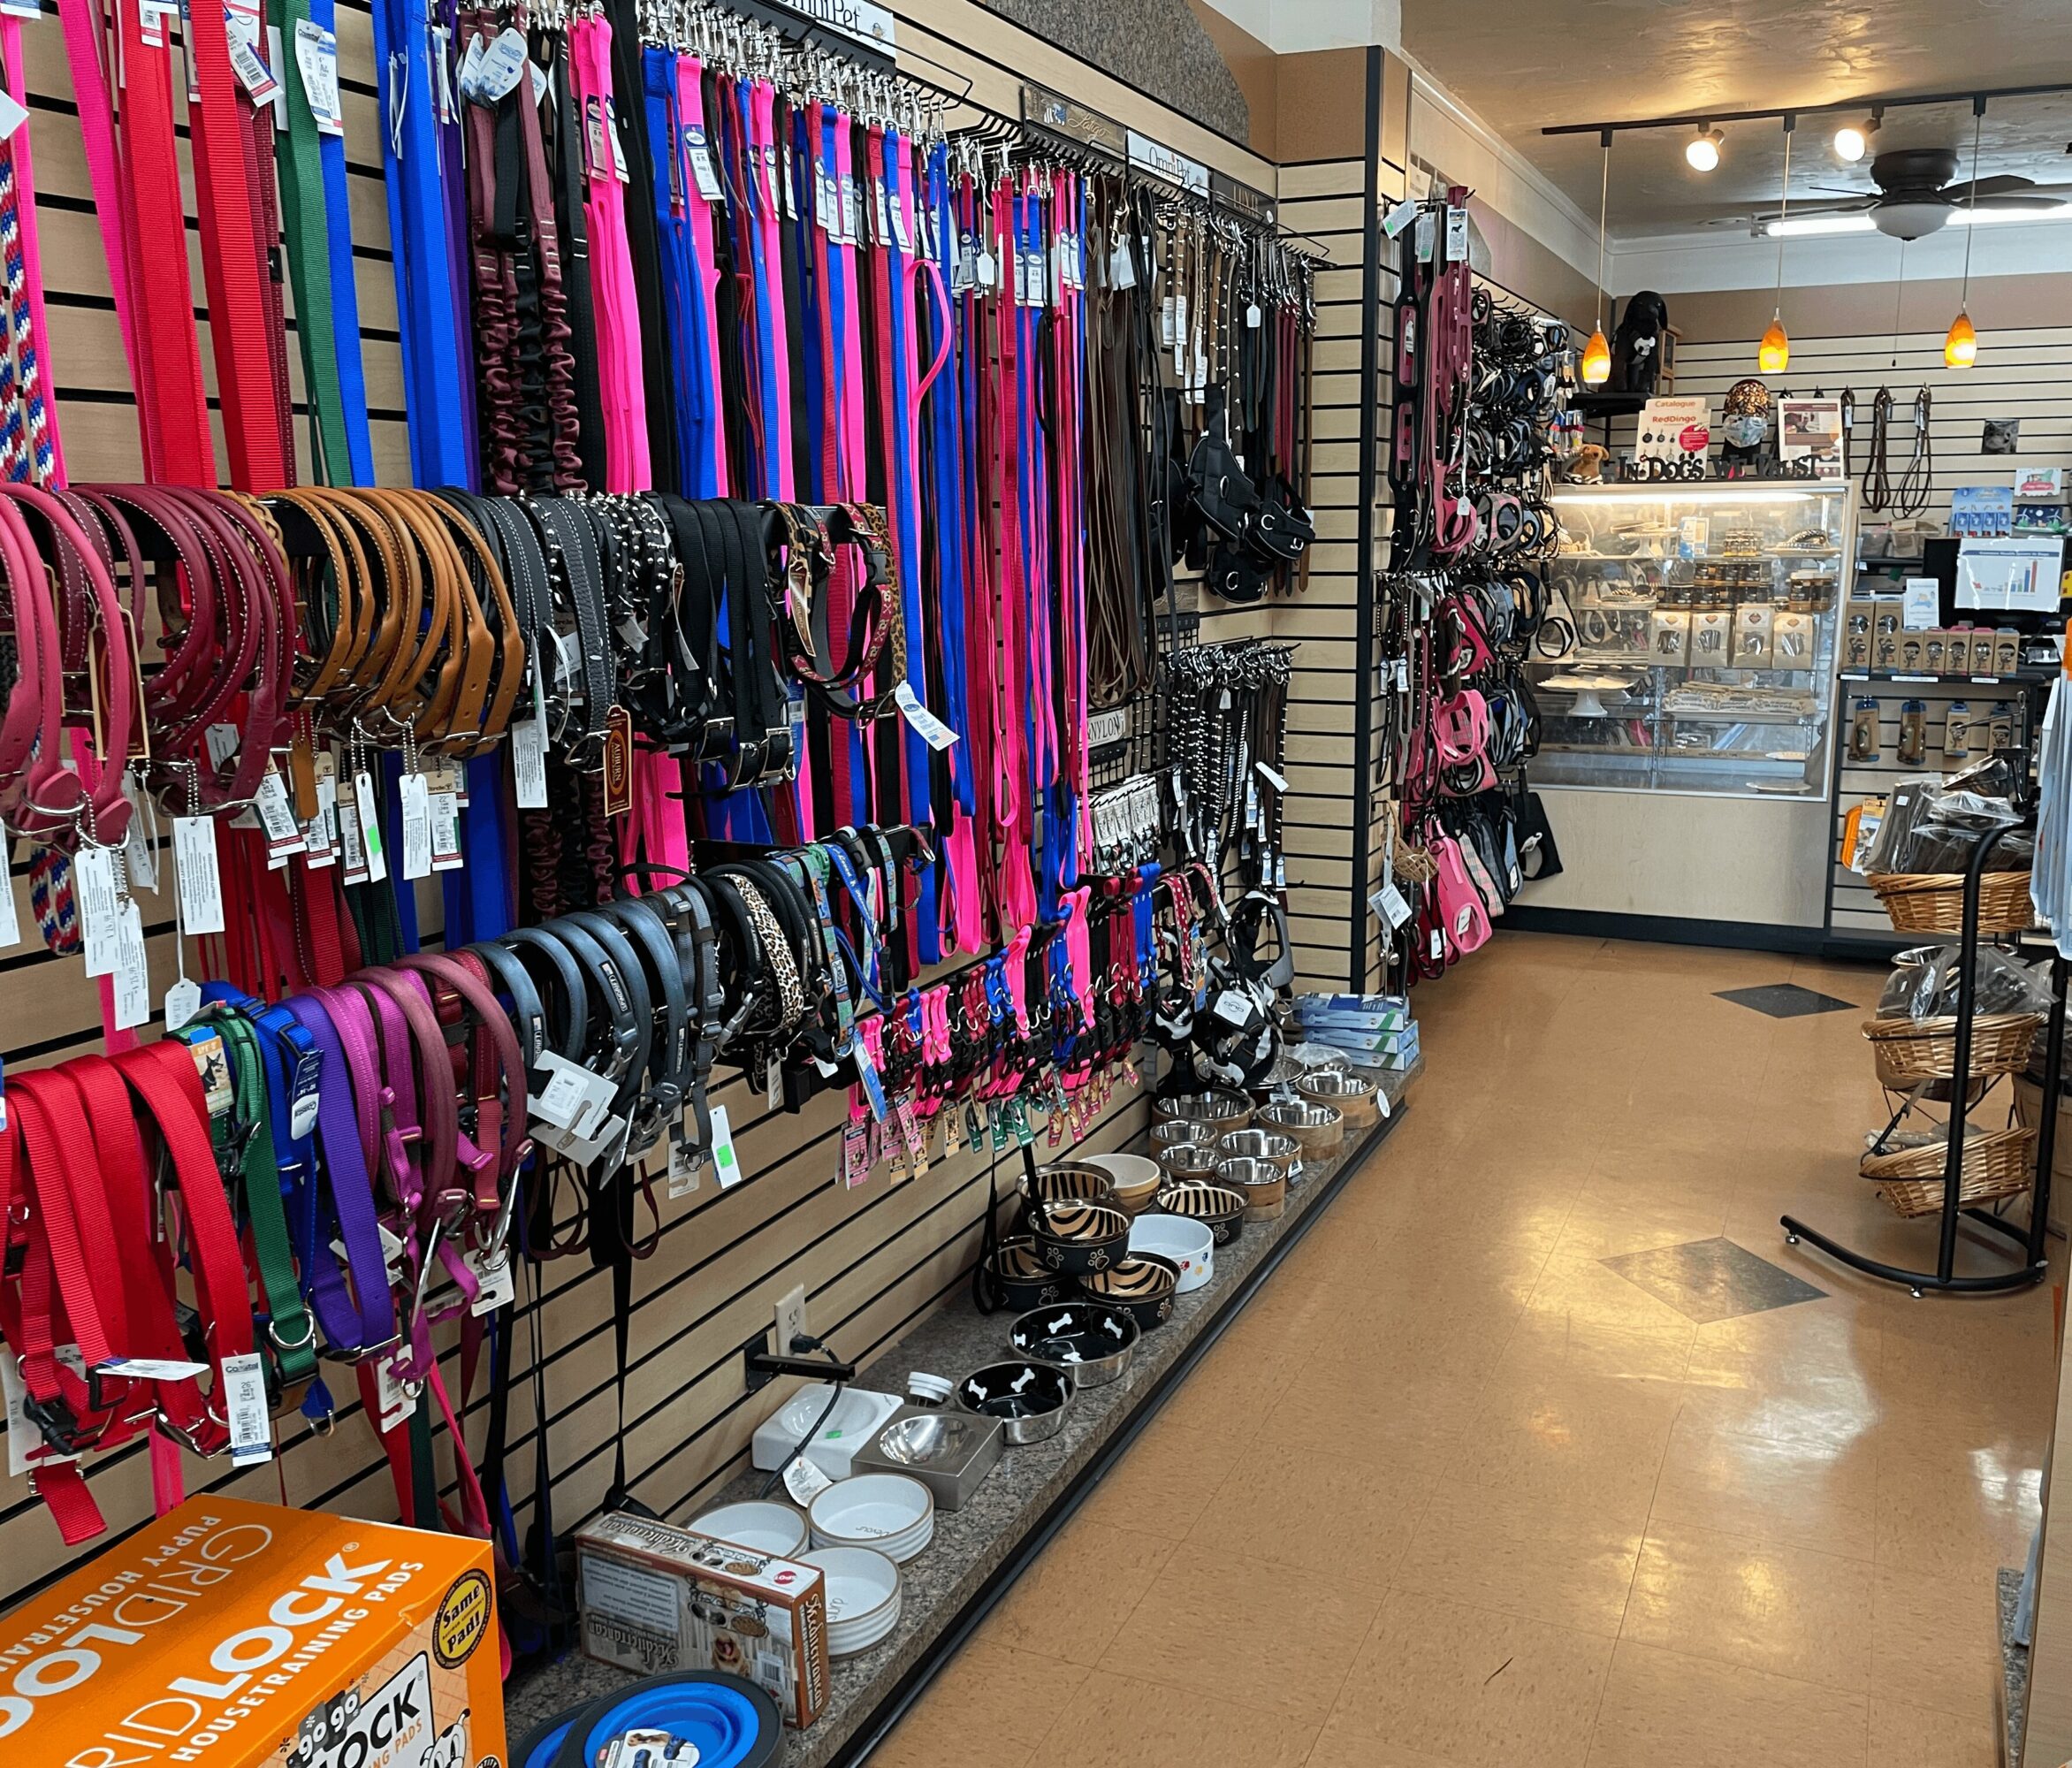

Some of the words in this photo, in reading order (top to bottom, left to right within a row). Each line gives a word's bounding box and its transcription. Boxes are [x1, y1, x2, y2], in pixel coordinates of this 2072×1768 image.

[780, 0, 860, 30] mniPet
[1149, 146, 1192, 183] OmniPet
[613, 743, 622, 782] AUBURN
[141, 1515, 222, 1567] PUPPY
[602, 1518, 696, 1556] Mediterranean
[443, 1584, 480, 1628] Same
[447, 1611, 480, 1655] Pad!
[587, 1618, 679, 1668] Mediterranean
[805, 1592, 824, 1710] Mediterranean
[65, 1552, 393, 1768] RIDLOCK
[169, 1608, 369, 1763] HOUSETRAINING
[363, 1561, 424, 1602] PADS
[319, 1676, 421, 1768] OCK
[395, 1718, 423, 1755] PADS
